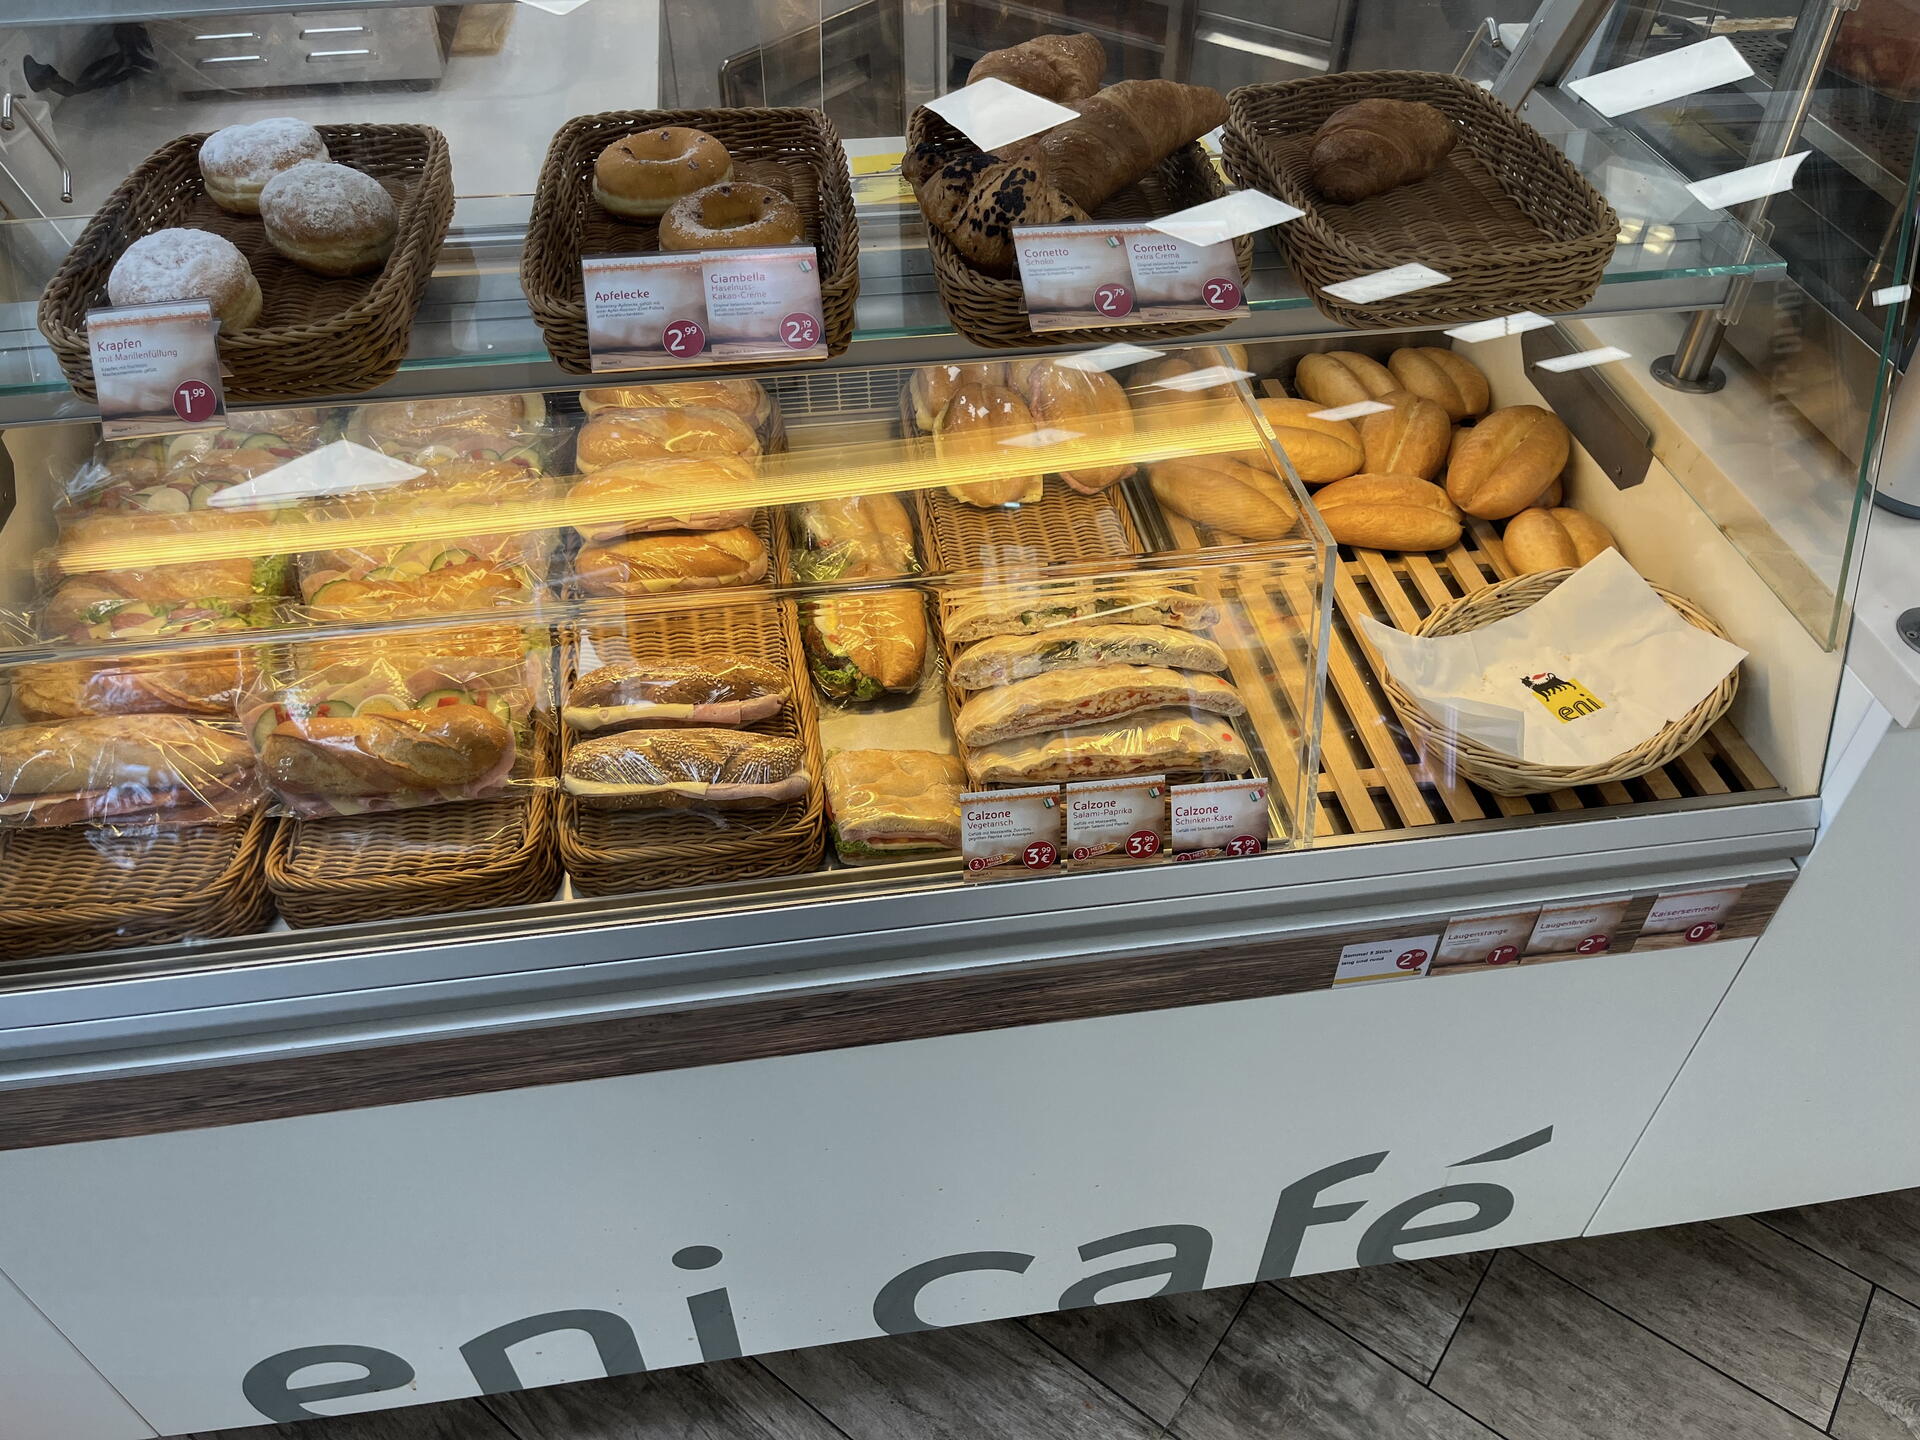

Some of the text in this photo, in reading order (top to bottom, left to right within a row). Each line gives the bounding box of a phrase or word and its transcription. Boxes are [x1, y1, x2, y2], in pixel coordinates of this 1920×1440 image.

[1024, 248, 1069, 258] Cornetto
[1133, 243, 1177, 253] Cornetto
[1025, 258, 1054, 266] Schoko
[711, 272, 766, 284] Ciambella
[594, 289, 650, 302] Apfelecke
[97, 338, 142, 352] Krapfen
[1558, 693, 1602, 722] eni
[1073, 800, 1117, 811] Calzone
[1175, 806, 1219, 817] Calzone
[967, 810, 1011, 822] Calzone
[1073, 807, 1133, 819] Salami-Paprika
[967, 819, 1014, 831] Vegetarisch
[1650, 904, 1720, 918] Kaisersemmel
[1540, 917, 1598, 930] Laugenbrezel
[1447, 928, 1509, 941] Laugenstange
[242, 1125, 1554, 1424] eni café
